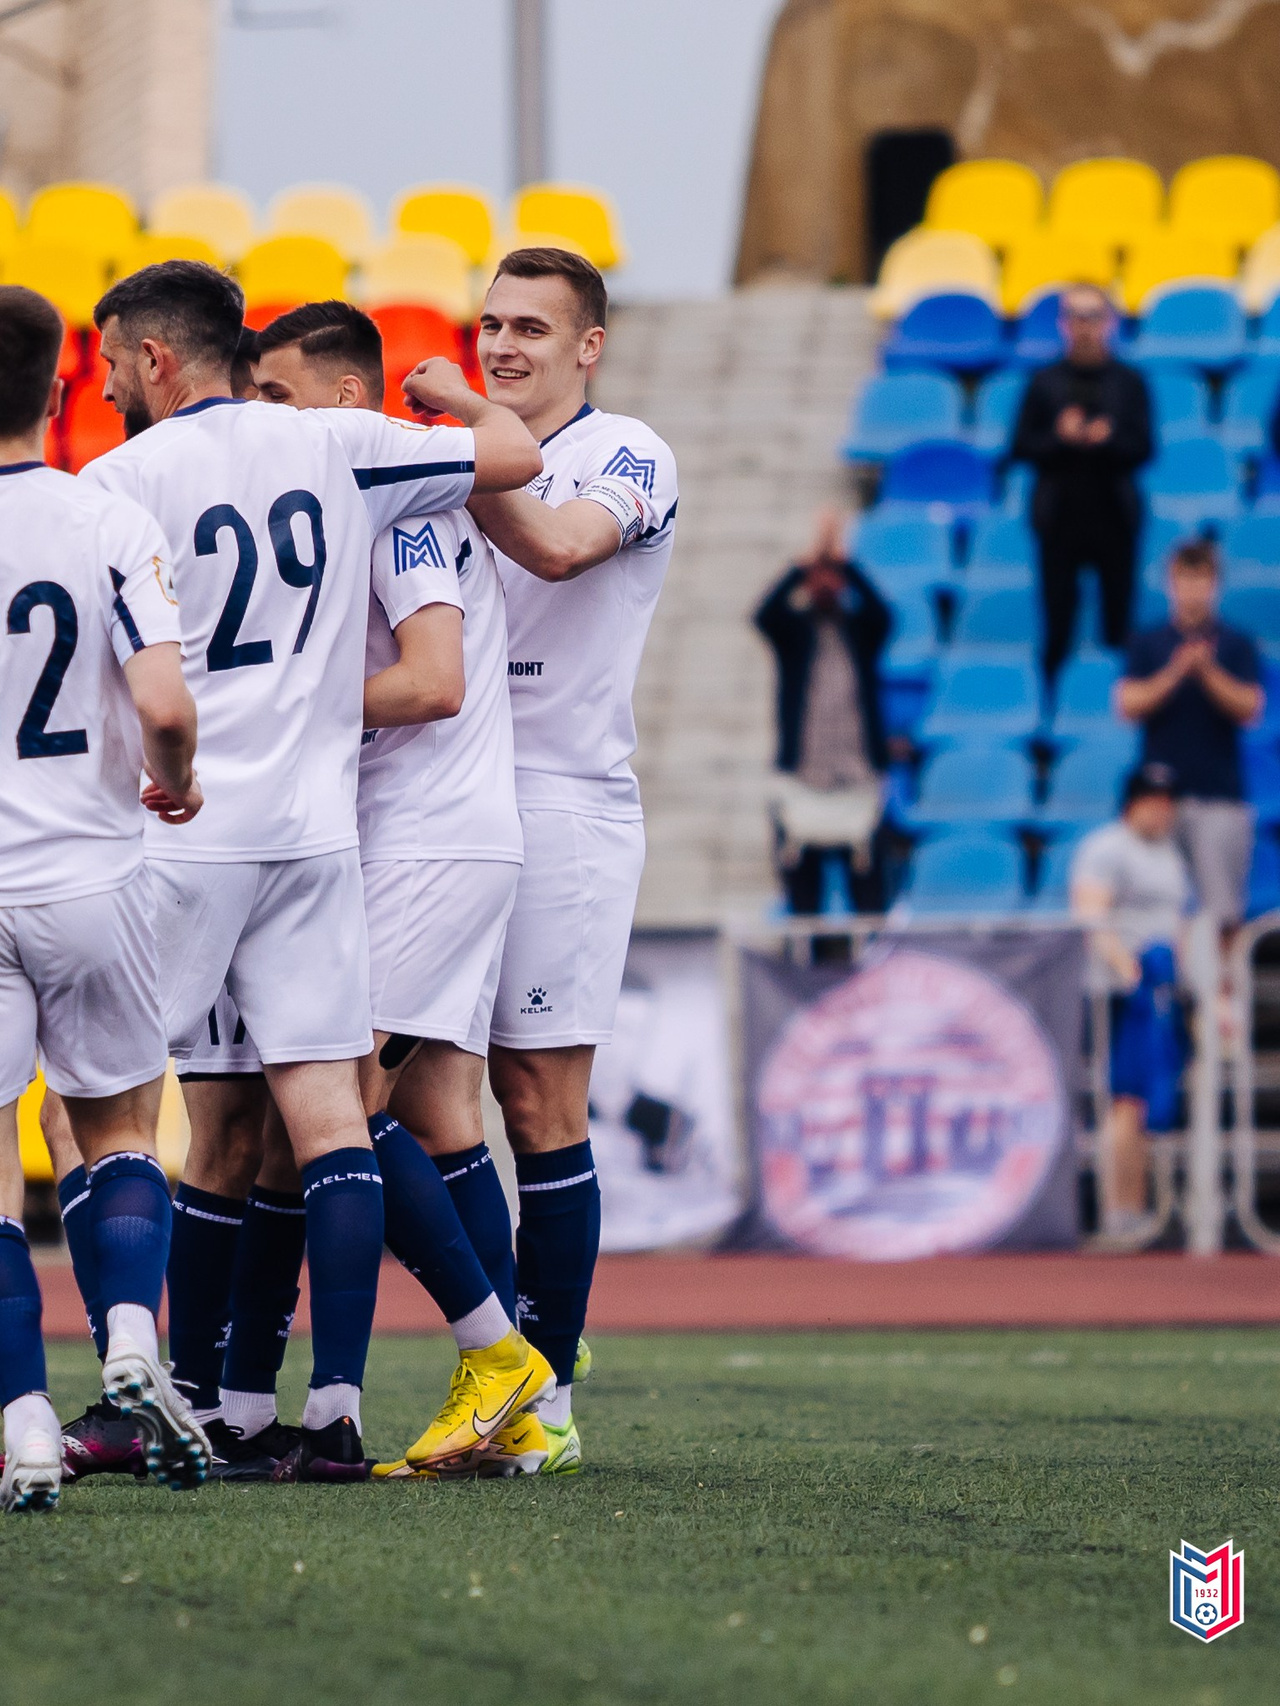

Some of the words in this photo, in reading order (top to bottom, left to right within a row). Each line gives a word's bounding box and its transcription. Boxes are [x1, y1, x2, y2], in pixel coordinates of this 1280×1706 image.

[194, 490, 327, 673] 29
[520, 1005, 553, 1014] KELME
[311, 1172, 371, 1191] KELME
